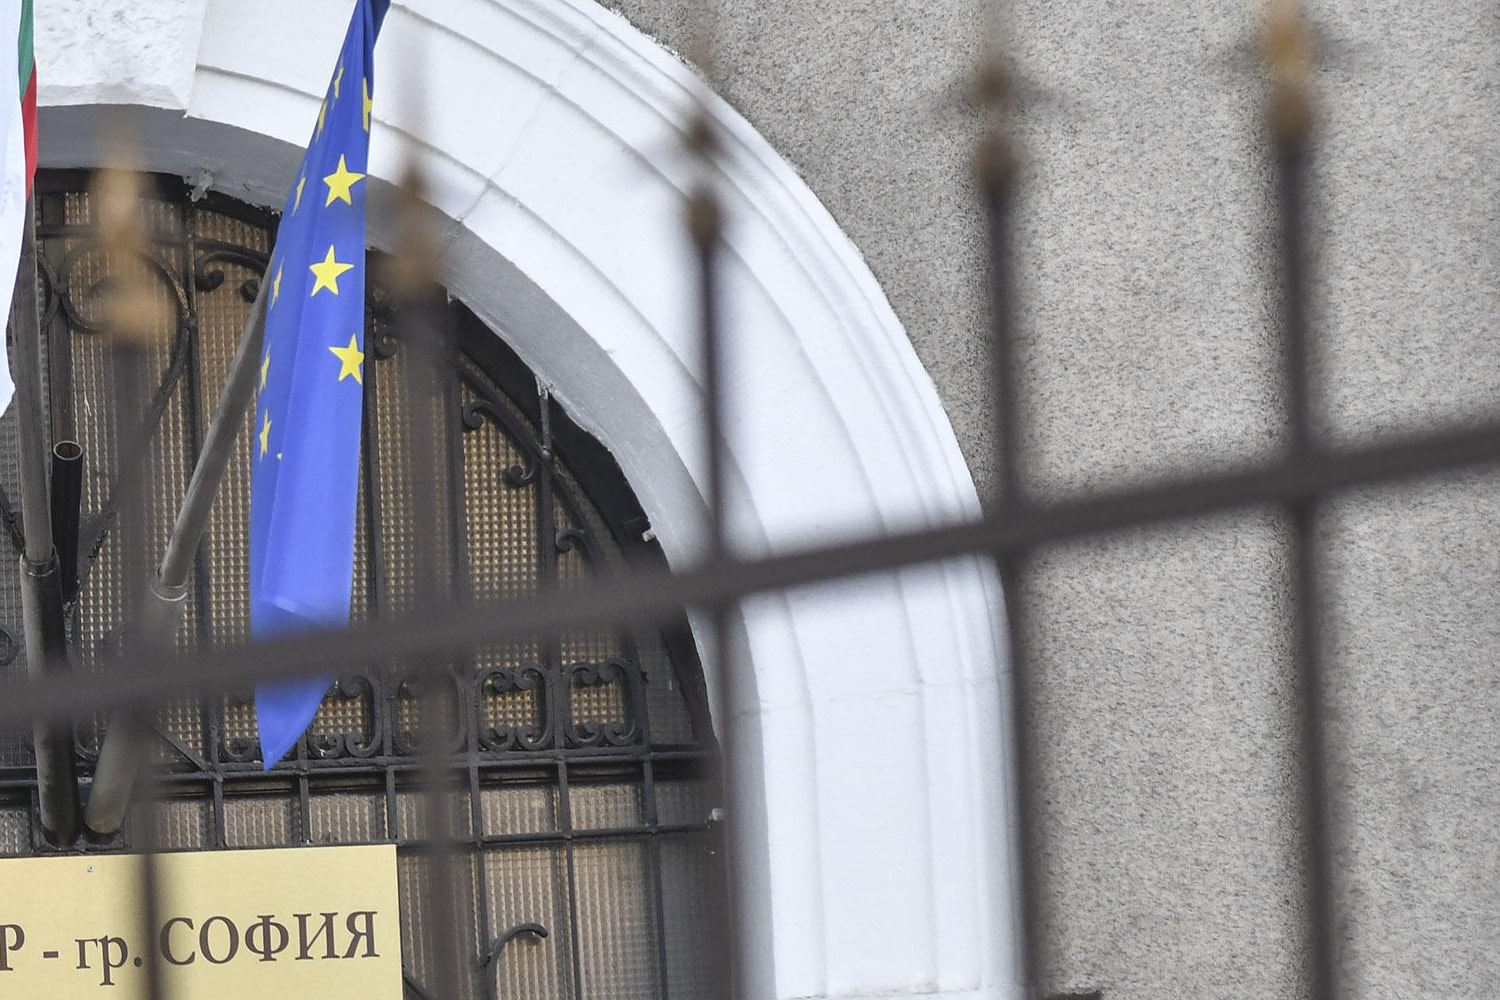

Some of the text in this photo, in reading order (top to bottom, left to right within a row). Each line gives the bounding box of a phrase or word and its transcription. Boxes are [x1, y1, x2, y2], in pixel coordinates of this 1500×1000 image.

[43, 950, 59, 959] -
[74, 934, 143, 986] гр.
[158, 910, 380, 966] СОФИЯ
